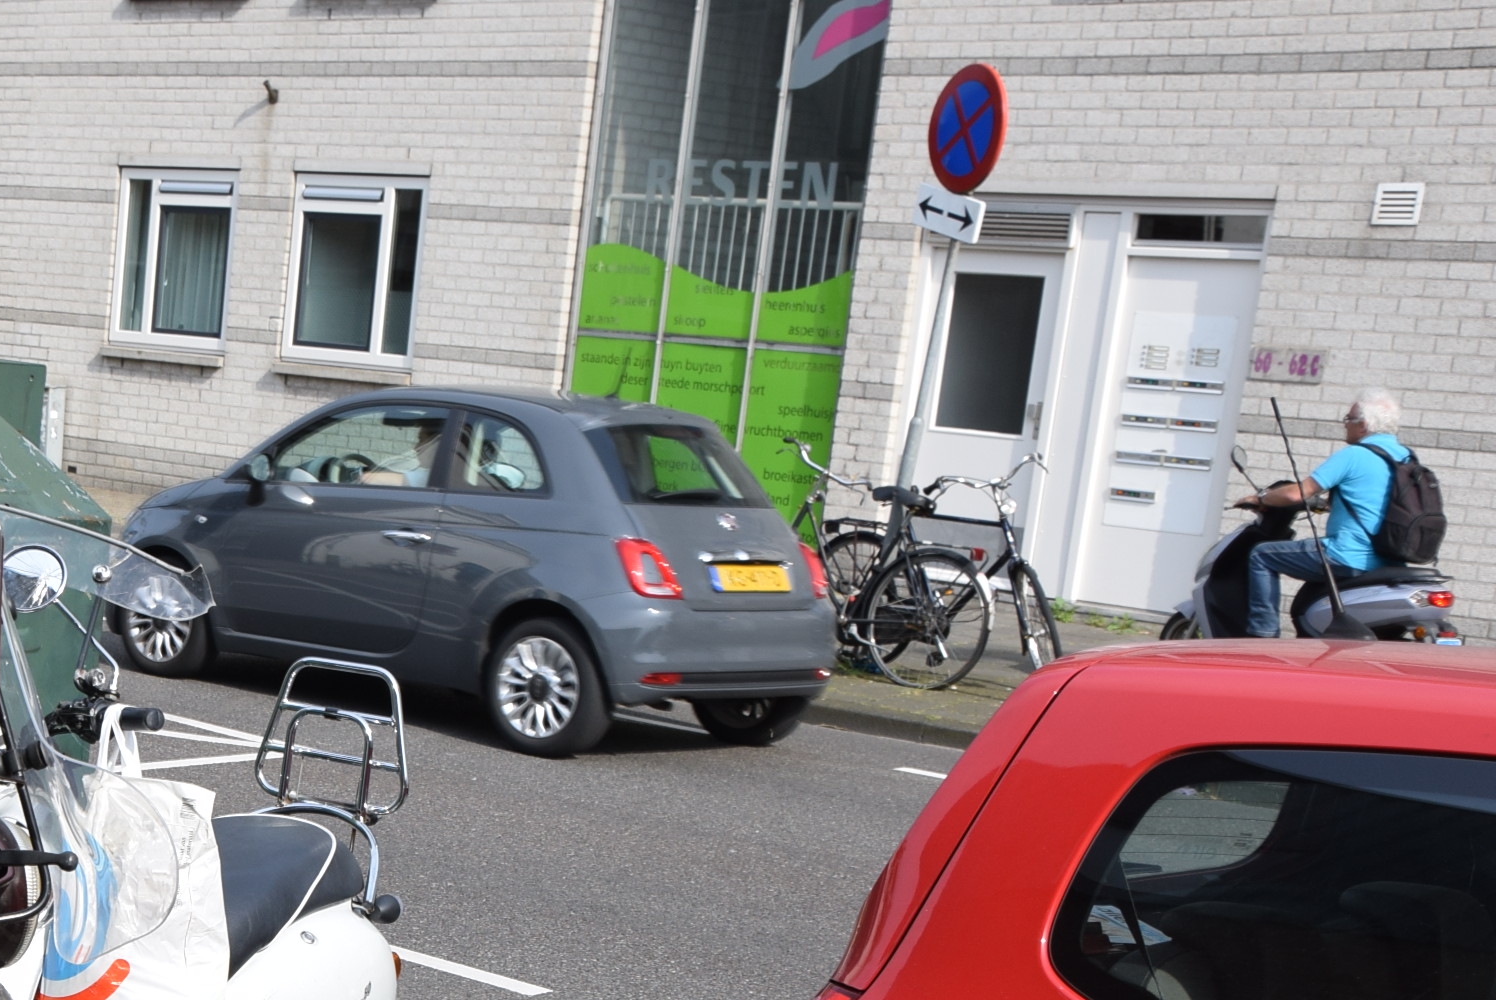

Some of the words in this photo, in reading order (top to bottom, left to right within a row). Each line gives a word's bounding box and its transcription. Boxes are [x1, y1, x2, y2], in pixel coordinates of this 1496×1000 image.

[645, 158, 839, 209] RESTEN
[581, 352, 620, 366] staande
[633, 357, 651, 369] zijn
[660, 358, 683, 371] uyn
[685, 358, 722, 374] buyten
[621, 373, 649, 386] deser
